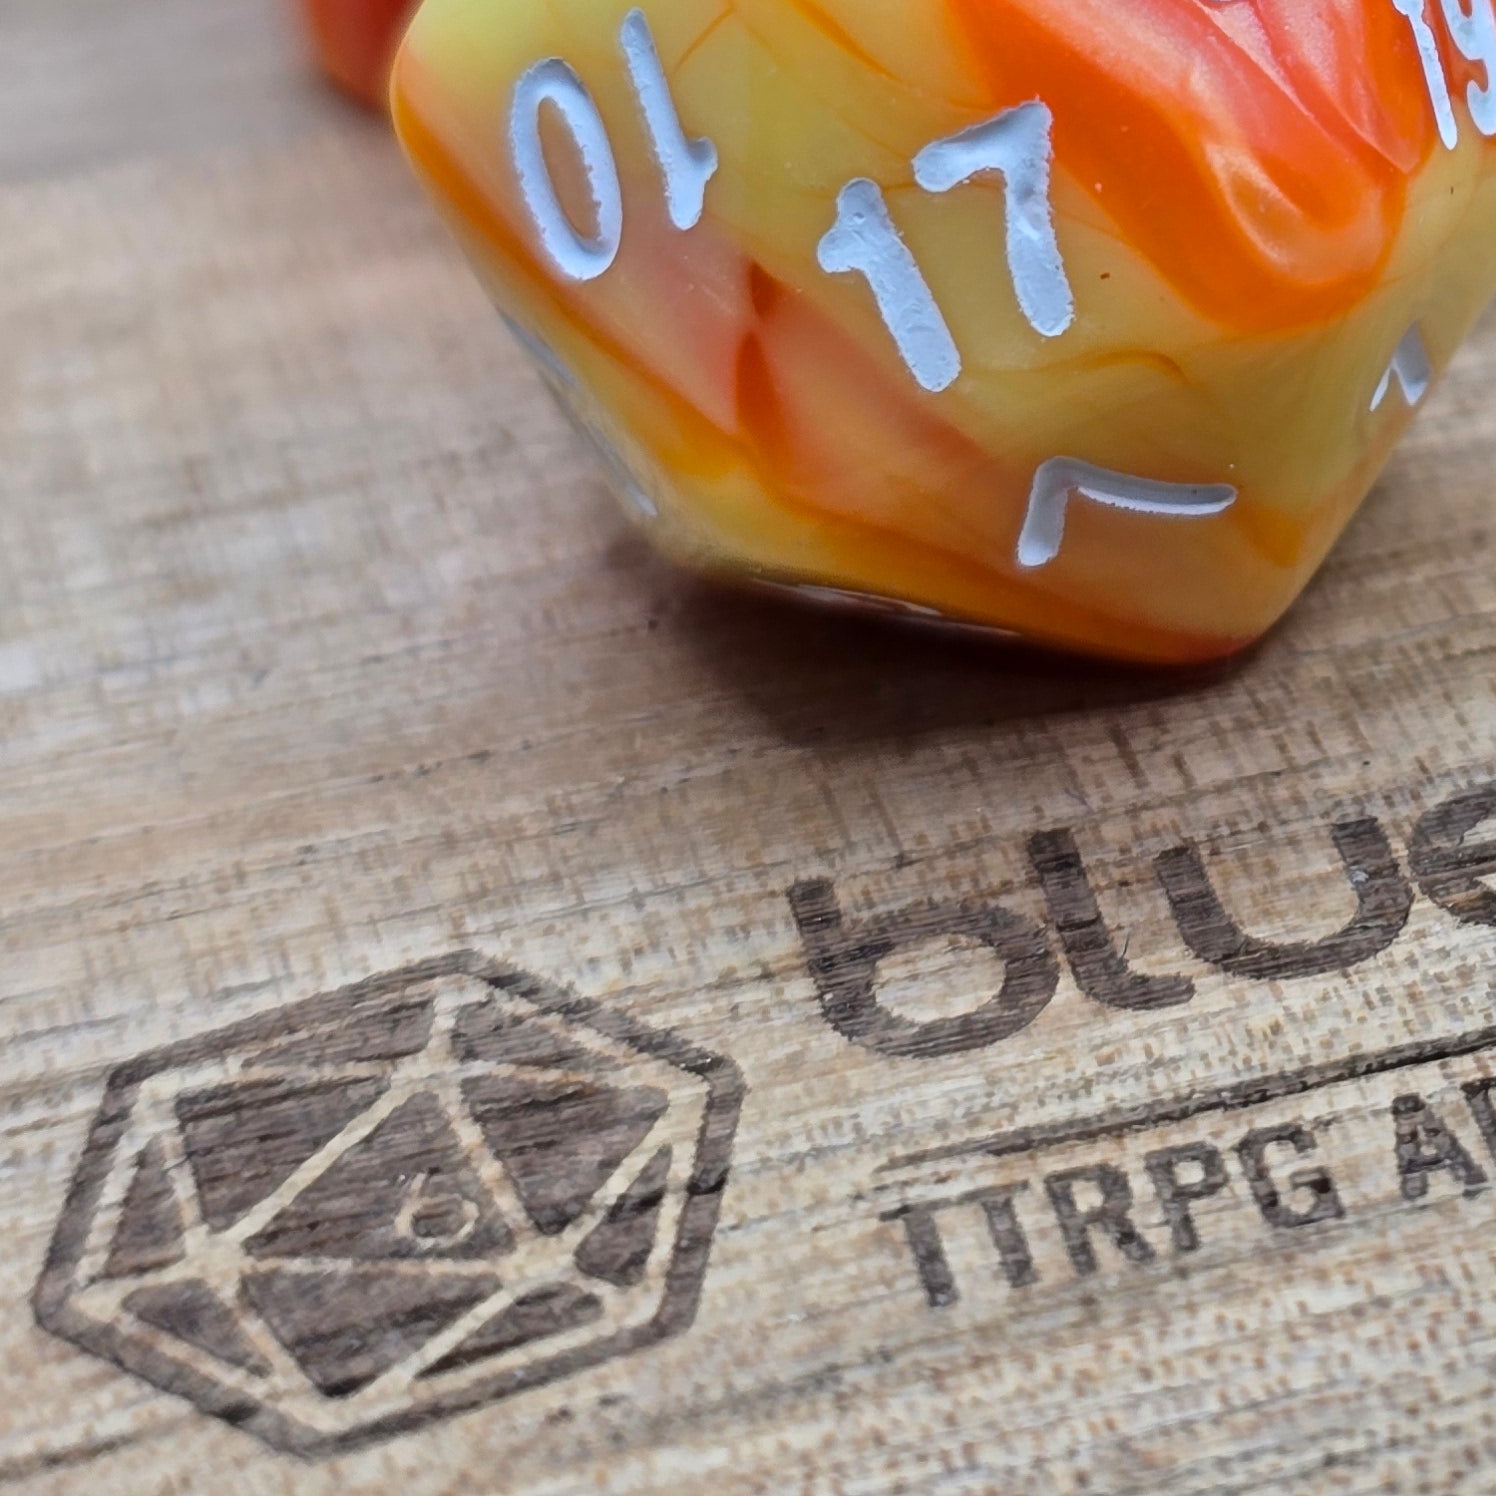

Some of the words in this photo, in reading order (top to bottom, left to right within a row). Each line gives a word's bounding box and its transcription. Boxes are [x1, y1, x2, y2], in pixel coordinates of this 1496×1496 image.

[507, 6, 718, 282] 10
[815, 96, 1077, 395] 17
[1015, 455, 1240, 569] 7
[880, 1118, 1346, 1308] TTRPG
